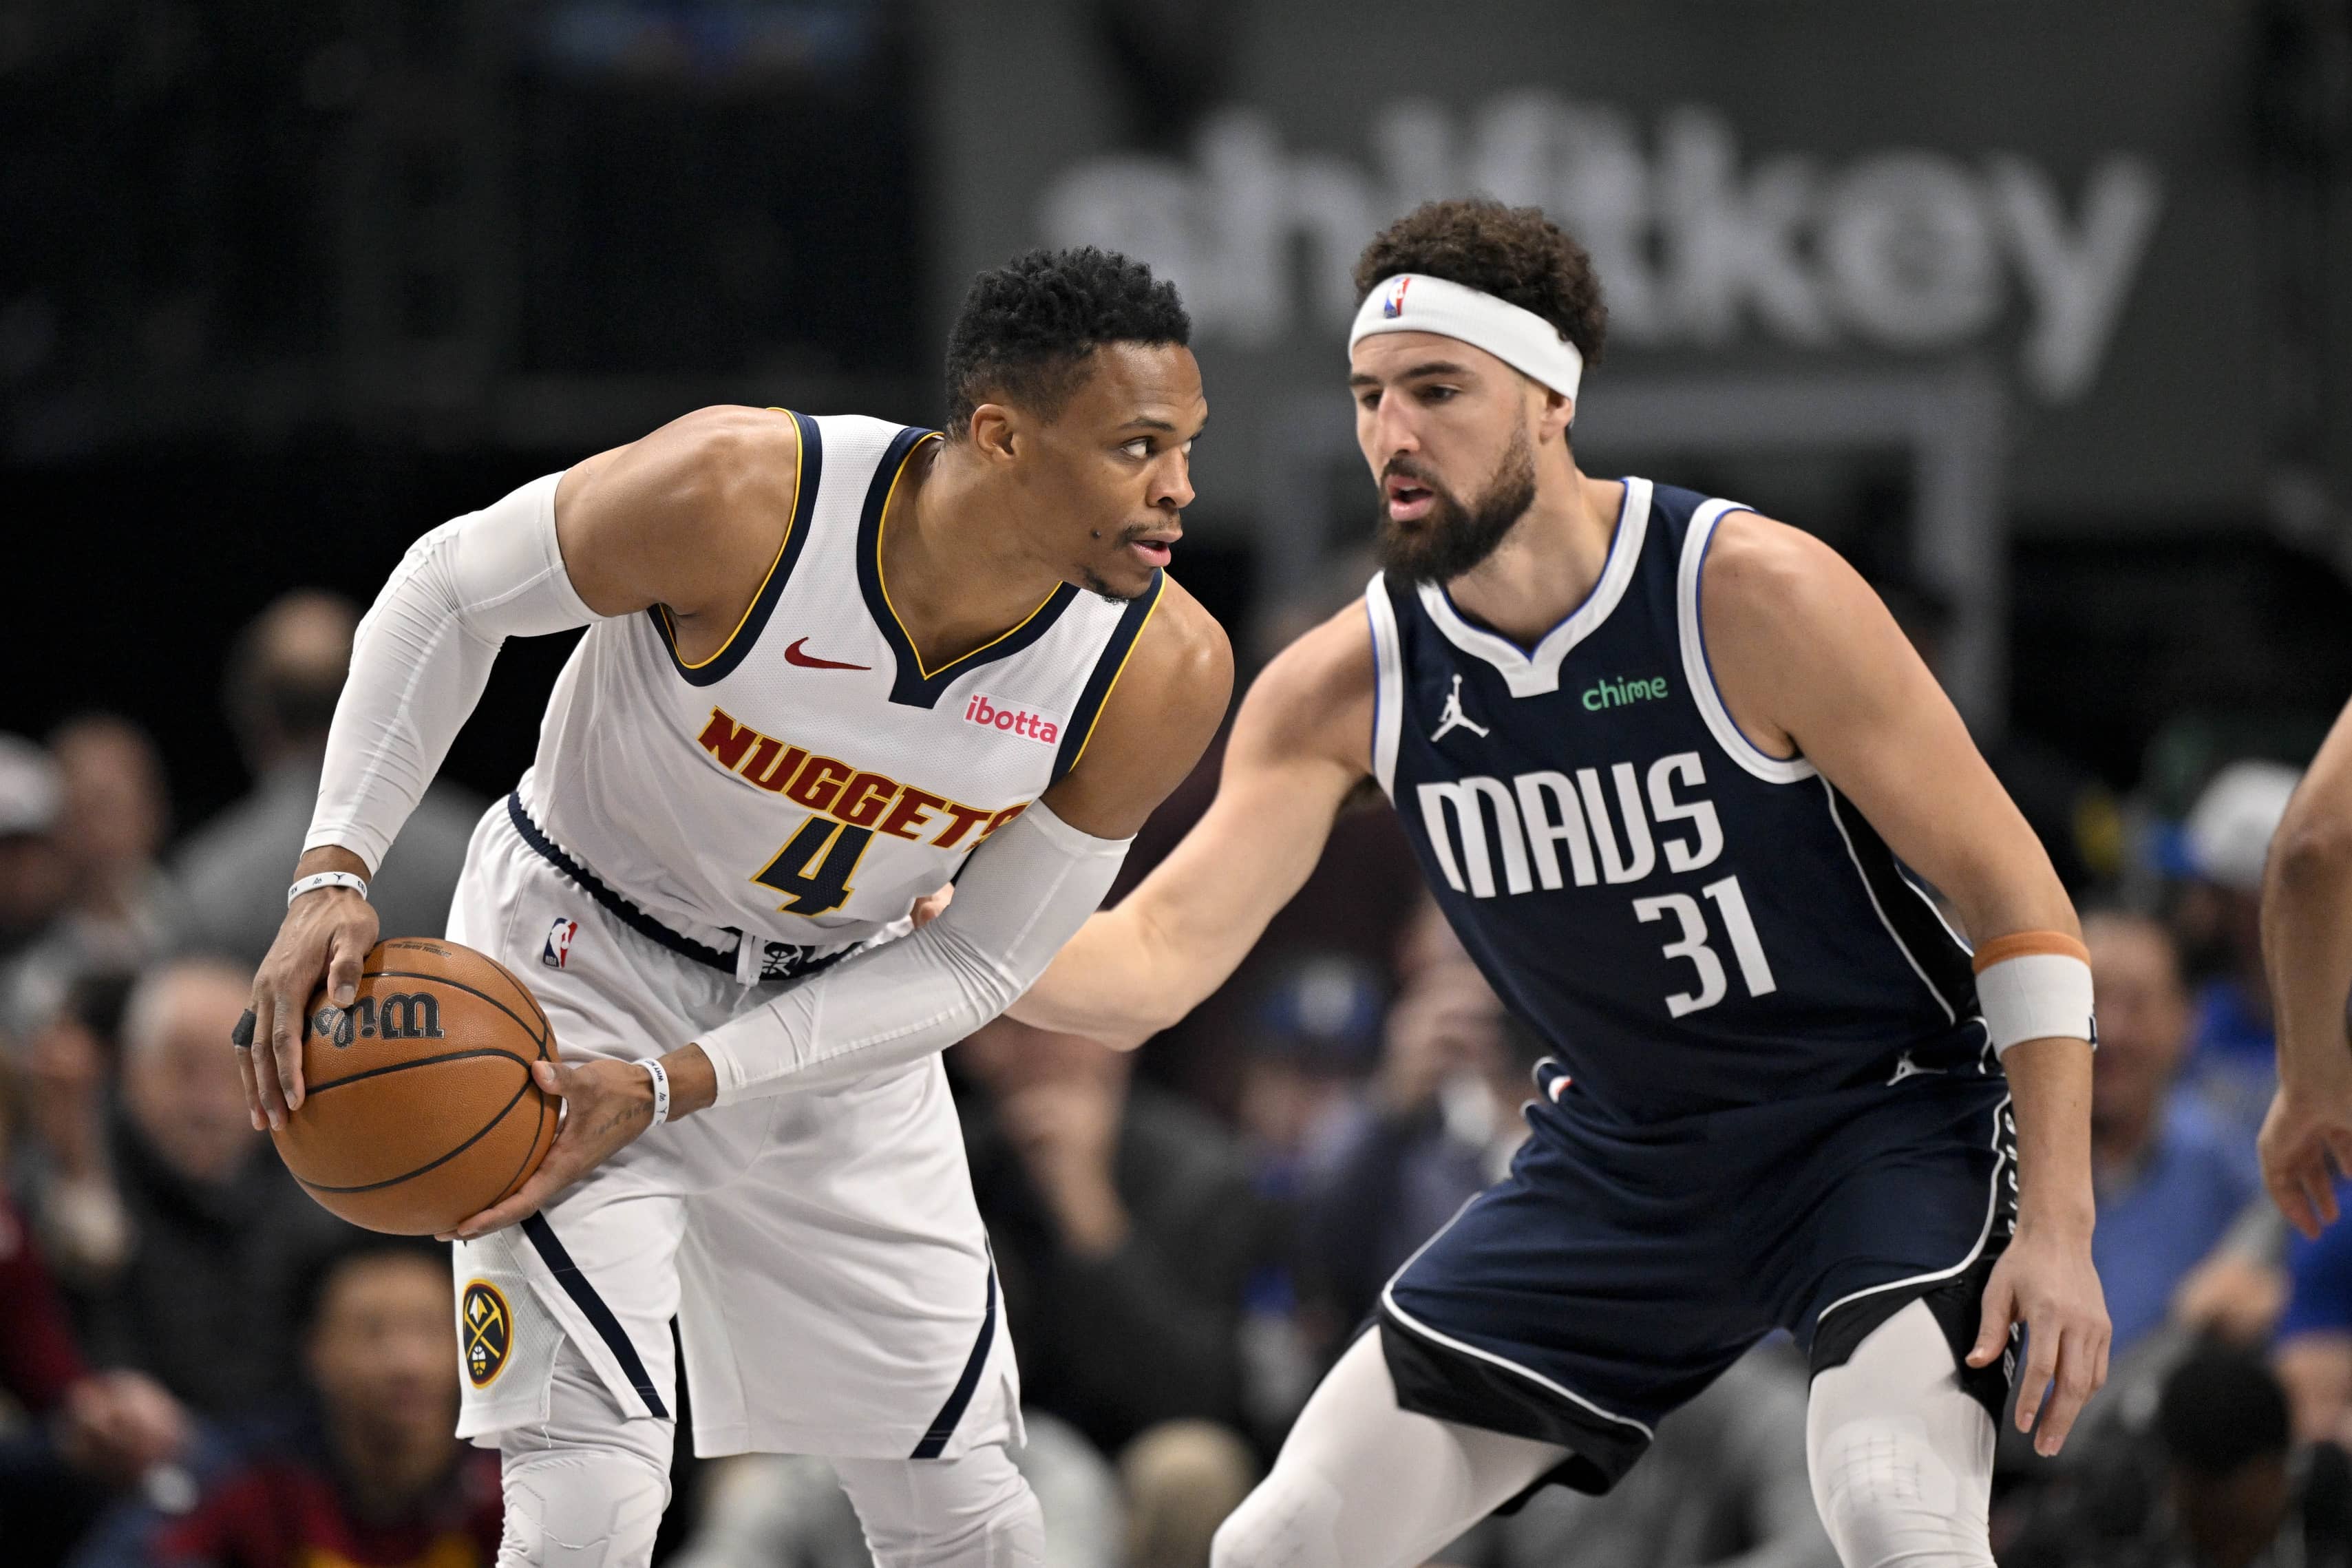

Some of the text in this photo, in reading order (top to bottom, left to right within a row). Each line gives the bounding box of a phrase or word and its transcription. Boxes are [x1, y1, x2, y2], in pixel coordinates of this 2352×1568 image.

[965, 695, 1059, 745] ibotta
[1582, 676, 1668, 711] chime
[1416, 751, 1724, 898] MAVS
[749, 813, 879, 918] 4
[1632, 875, 1777, 1019] 31
[304, 992, 445, 1050] Wils
